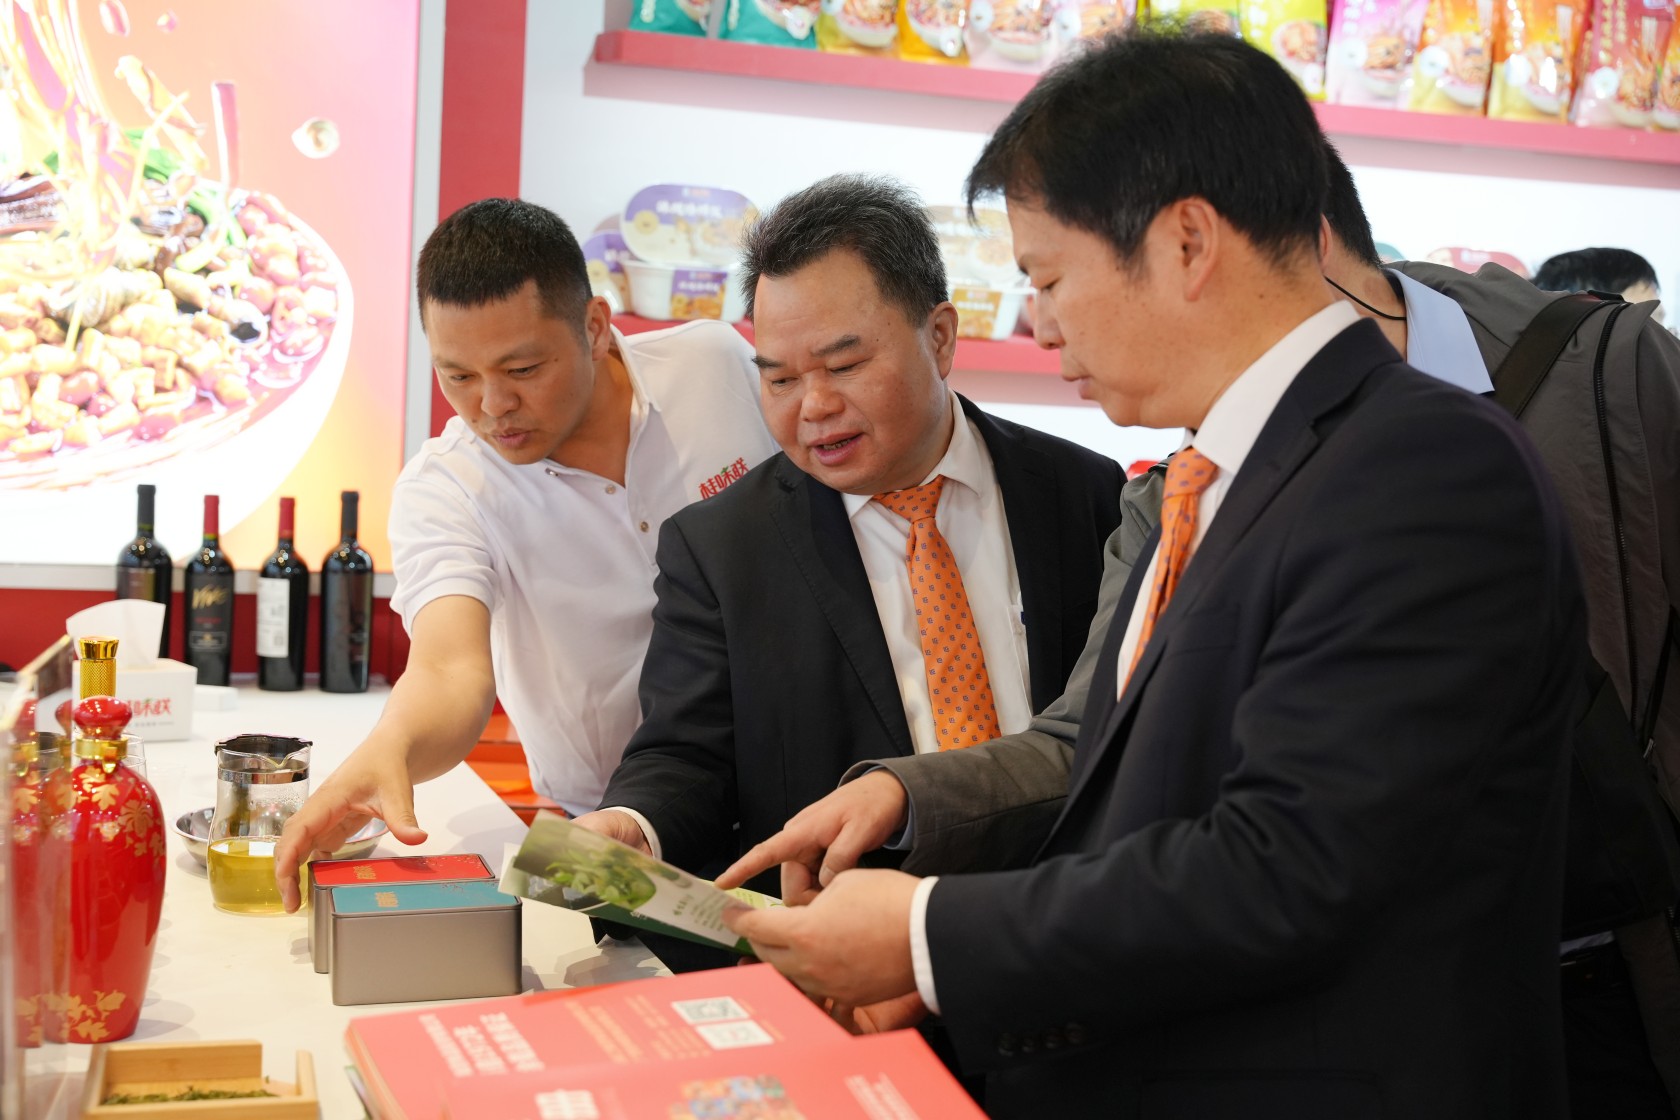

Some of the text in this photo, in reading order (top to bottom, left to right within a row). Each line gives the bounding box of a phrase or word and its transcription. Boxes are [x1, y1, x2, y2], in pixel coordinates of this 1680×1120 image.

[699, 457, 750, 500] 桂味联
[127, 697, 172, 717] 味联
